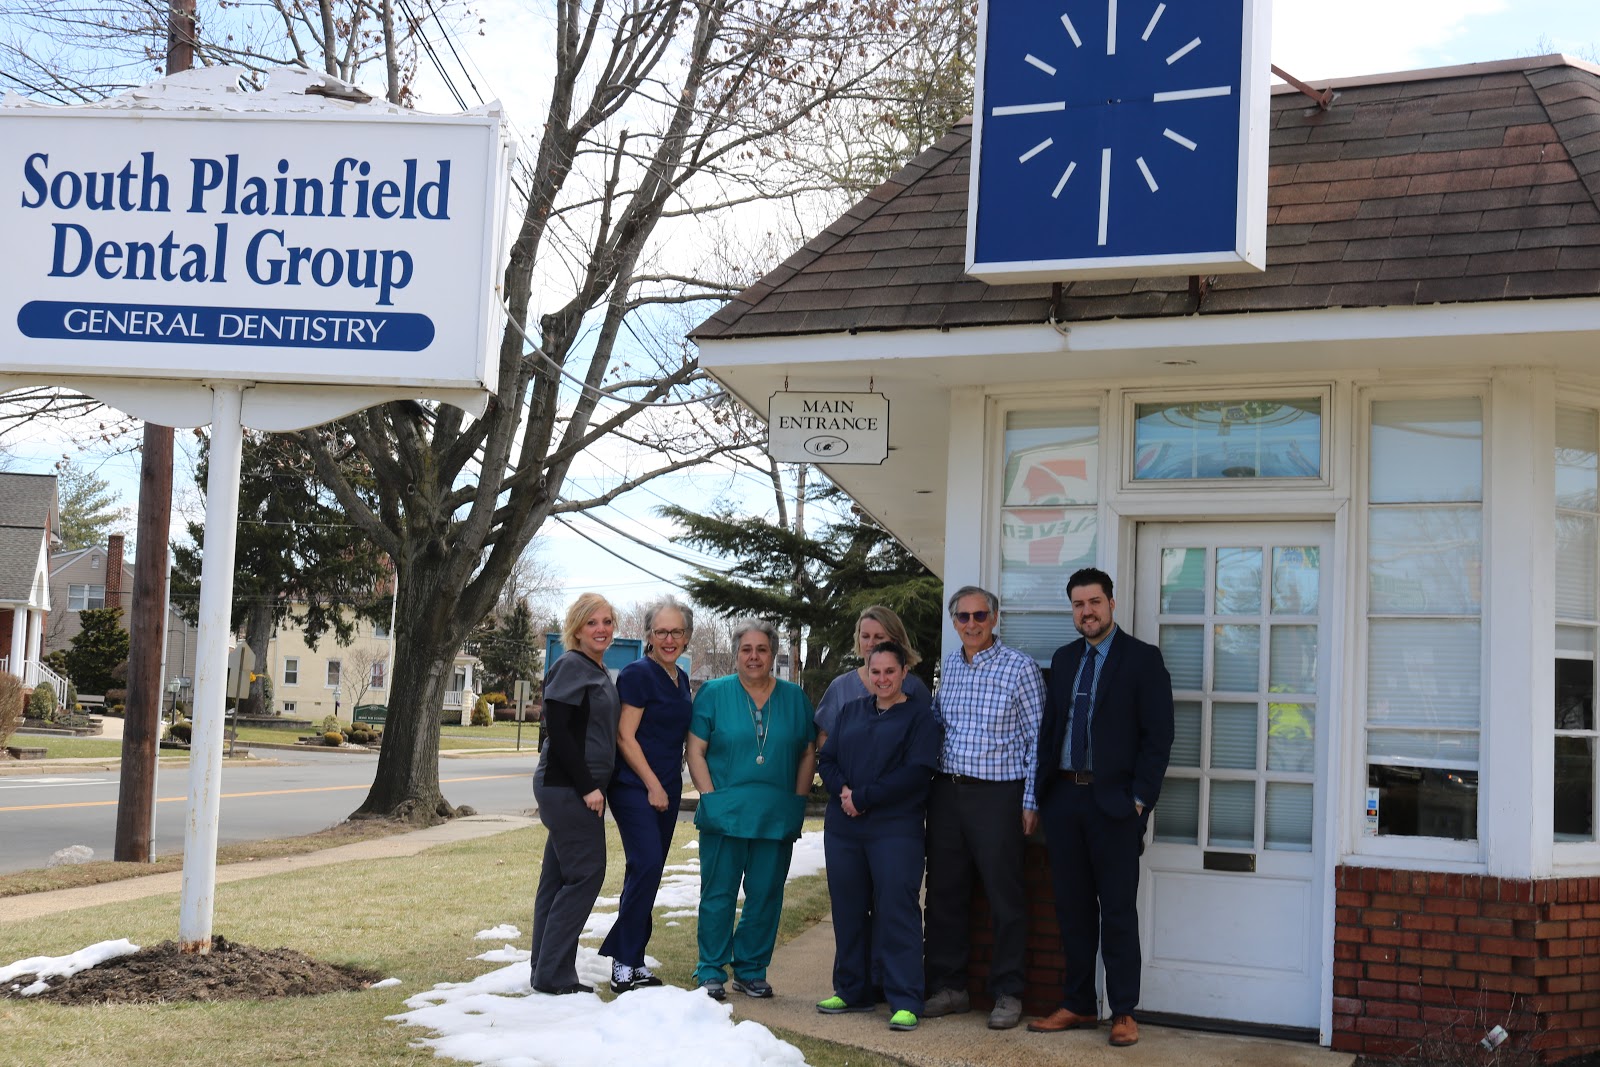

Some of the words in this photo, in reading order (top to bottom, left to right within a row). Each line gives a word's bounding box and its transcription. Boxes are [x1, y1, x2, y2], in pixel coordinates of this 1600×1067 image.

[22, 152, 171, 213] South
[187, 153, 450, 220] Plainfield
[48, 222, 229, 283] Dental
[246, 228, 413, 306] Group
[64, 308, 205, 337] GENERAL
[218, 314, 387, 343] DENTISTRY
[779, 416, 878, 431] ENTRANCE
[802, 400, 854, 414] MAIN
